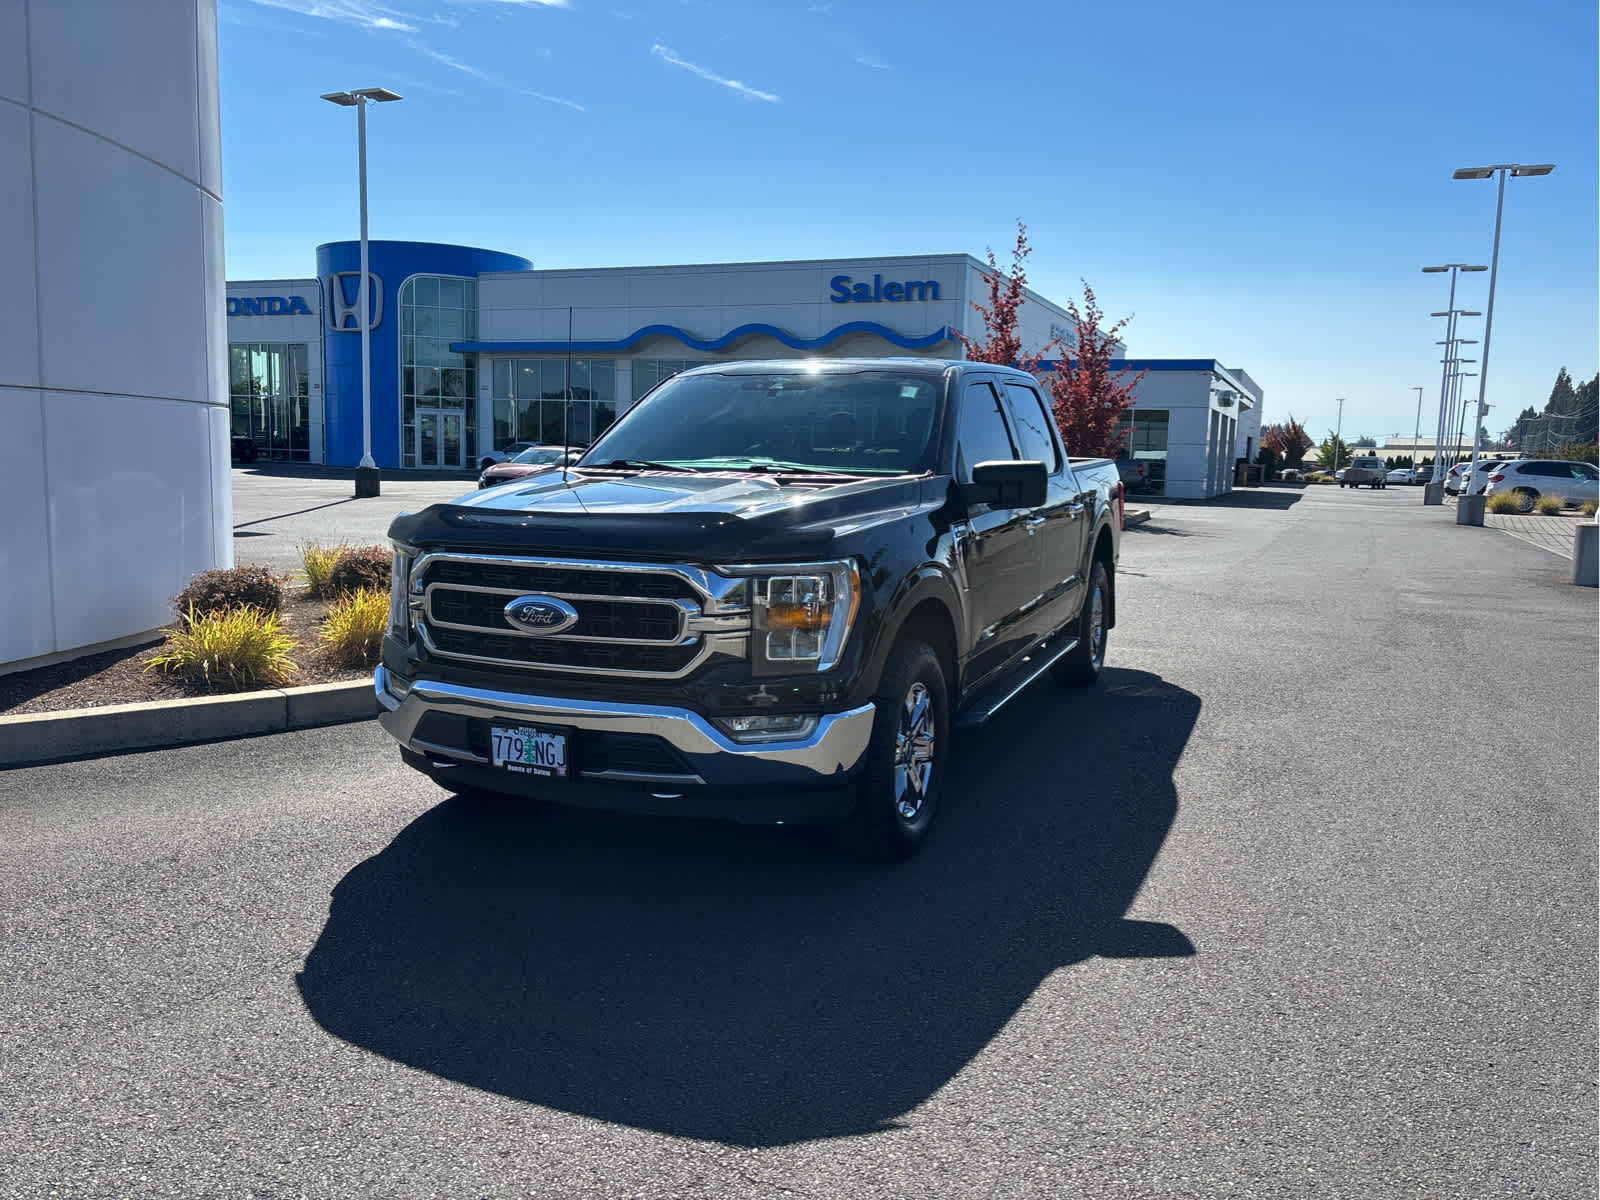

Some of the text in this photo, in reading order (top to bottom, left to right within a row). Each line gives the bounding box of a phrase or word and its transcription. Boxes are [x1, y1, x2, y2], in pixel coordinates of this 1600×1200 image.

[830, 273, 940, 303] Salem
[226, 296, 313, 316] ONDA
[520, 605, 554, 624] Ford
[493, 735, 566, 767] 779 NGJ
